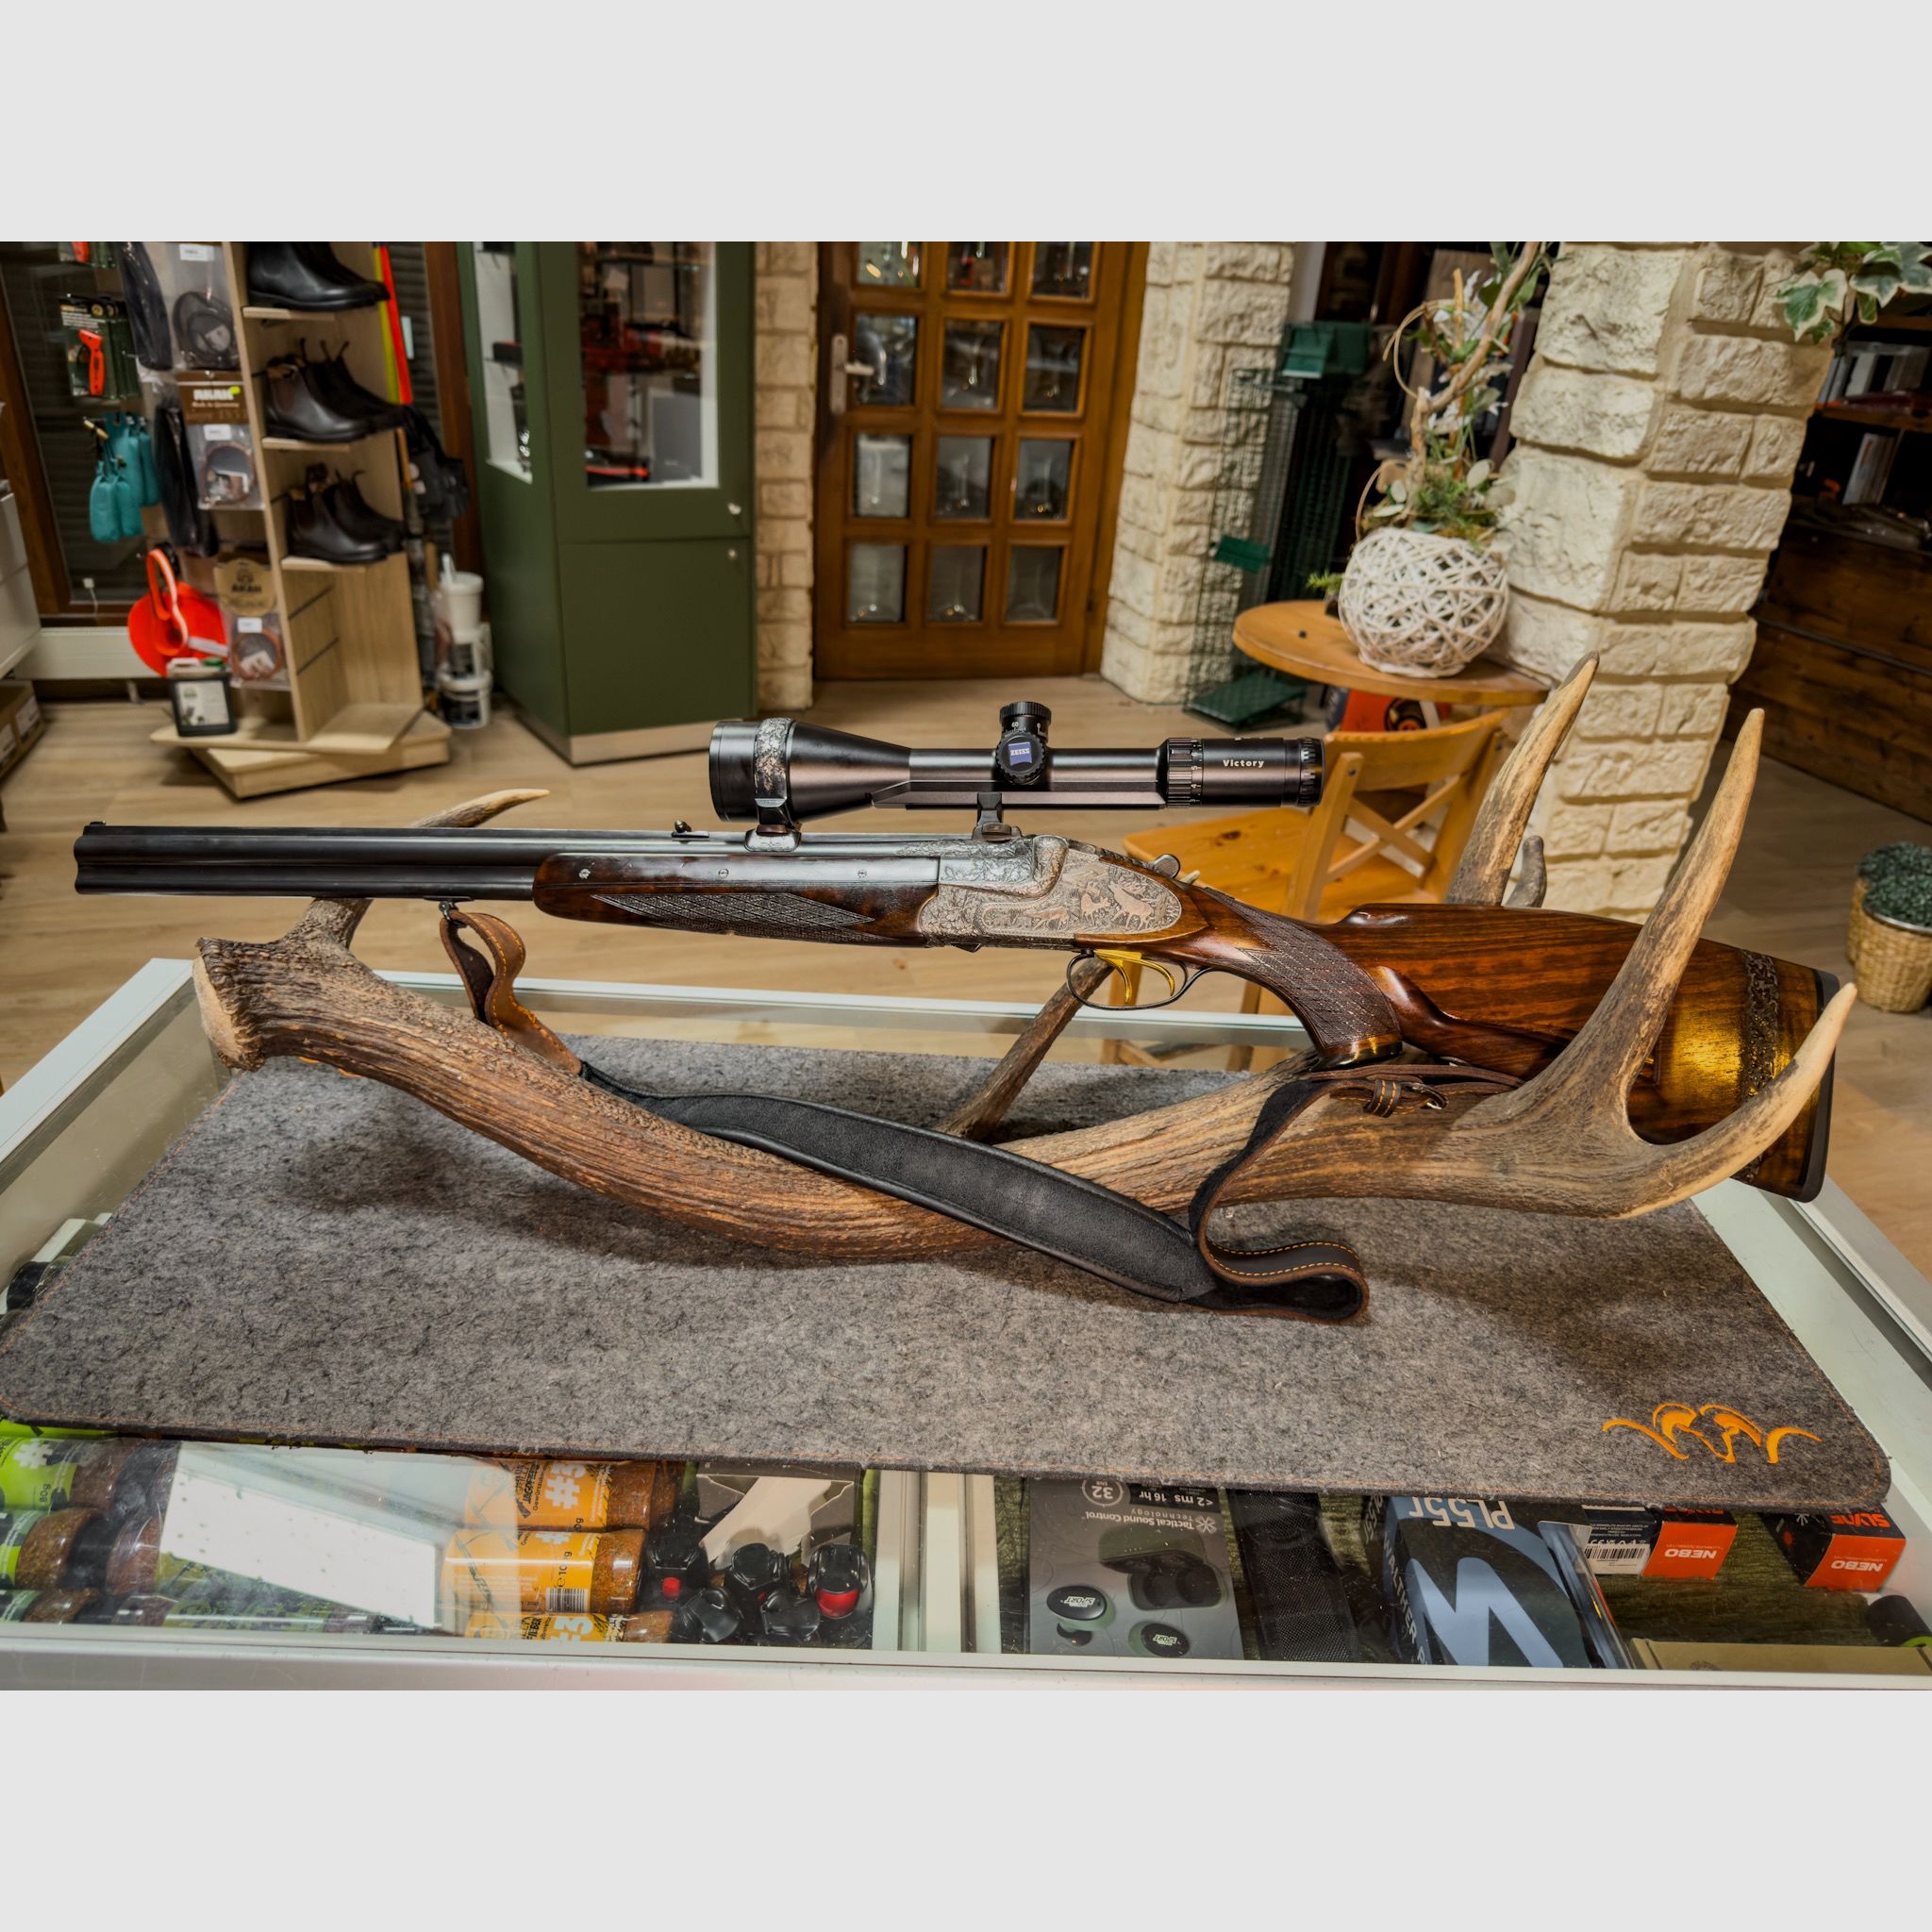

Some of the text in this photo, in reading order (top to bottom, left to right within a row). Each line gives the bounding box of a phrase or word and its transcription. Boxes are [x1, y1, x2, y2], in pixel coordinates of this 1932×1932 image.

[1223, 759, 1264, 768] Victory
[1091, 1485, 1114, 1500] 32
[1139, 1491, 1167, 1502] 16 hr
[1174, 1494, 1214, 1507] <2 ms
[1124, 1514, 1155, 1525] Sound
[1131, 1508, 1193, 1522] Technology
[1157, 1518, 1195, 1530] Tactical
[1664, 1548, 1718, 1559] NEBO
[1831, 1559, 1884, 1573] NEBO
[1383, 1532, 1417, 1643] WALTHER
[1064, 1595, 1095, 1606] SPORT
[1152, 1634, 1177, 1644] SPORT
